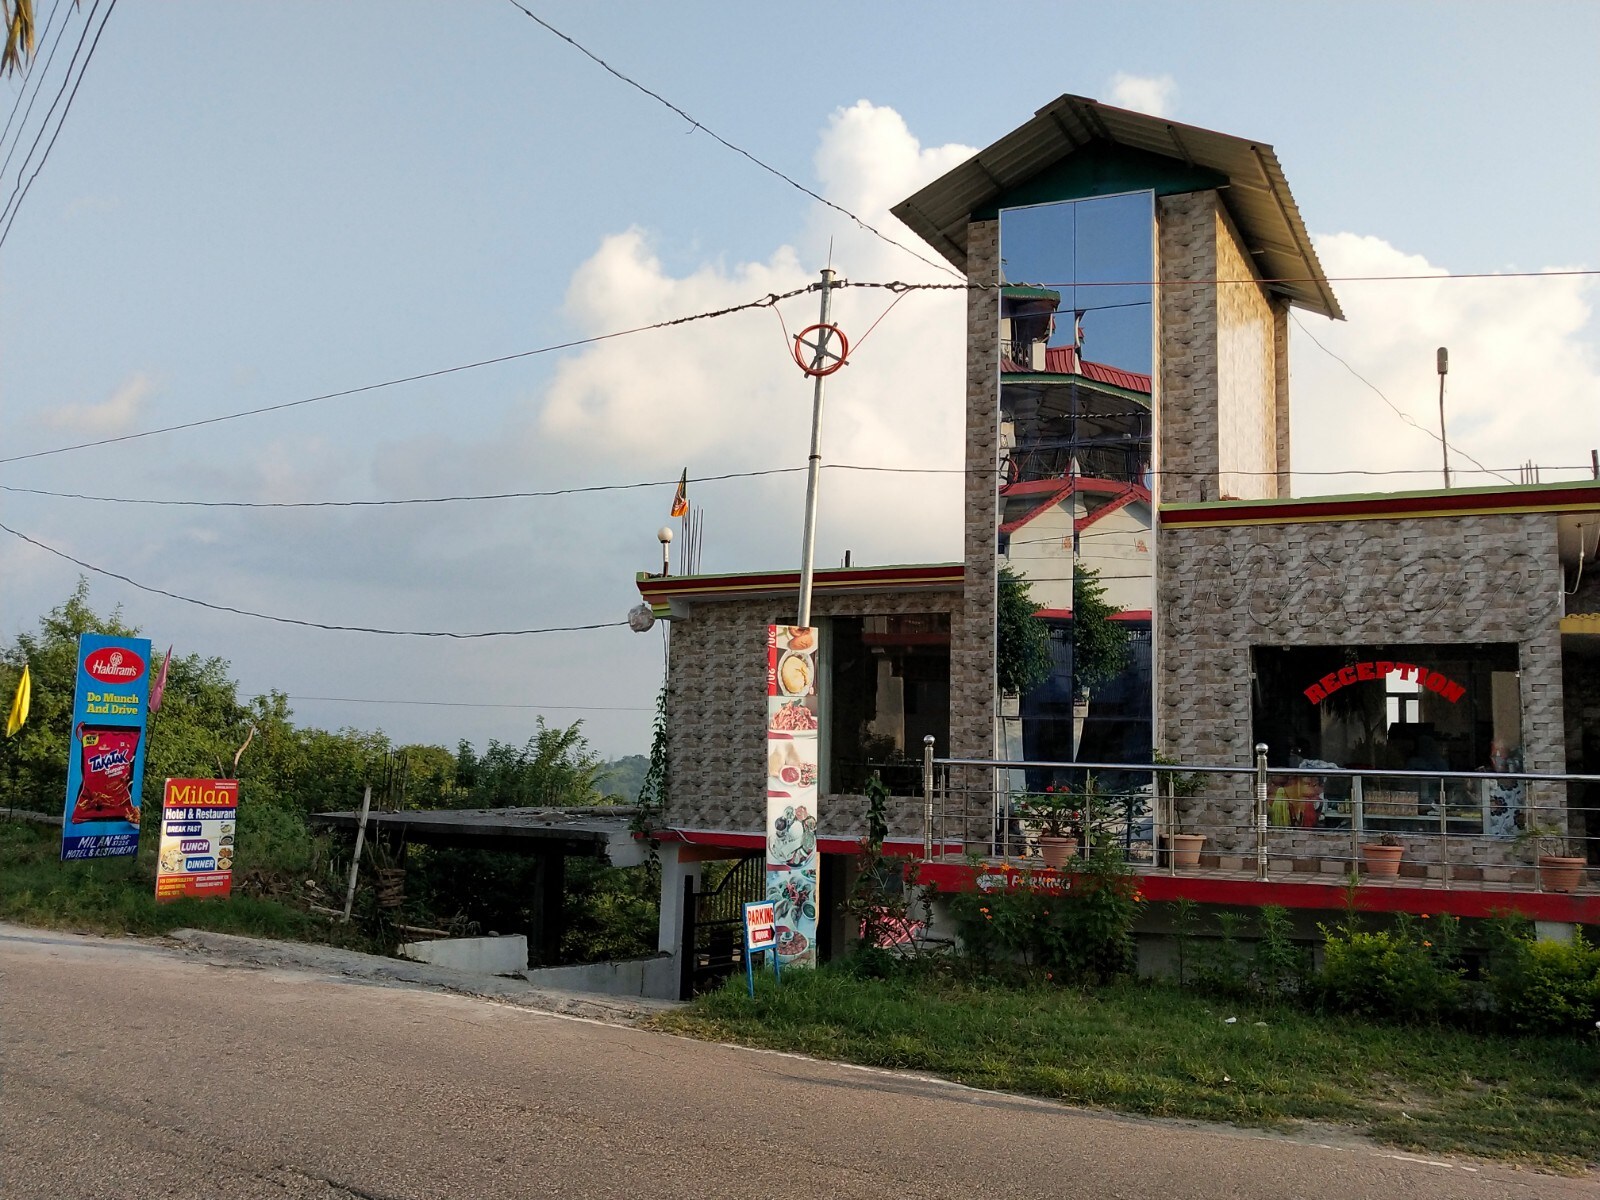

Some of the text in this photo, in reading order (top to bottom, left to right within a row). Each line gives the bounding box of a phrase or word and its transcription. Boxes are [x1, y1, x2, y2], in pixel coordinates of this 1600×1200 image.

[93, 660, 137, 676] Haldiram's
[1303, 661, 1467, 705] RECEPTION
[87, 692, 139, 704] Do Munch
[86, 703, 138, 715] And Drive
[88, 749, 129, 772] TAKATAK
[170, 785, 230, 805] Milan
[165, 808, 236, 819] Hotel & Restaurant
[78, 836, 113, 848] MILAN
[181, 842, 209, 851] LUNCH
[65, 849, 88, 859] HOTEL
[88, 848, 94, 857] &
[187, 860, 214, 869] DINNER
[748, 908, 774, 926] PARKING
